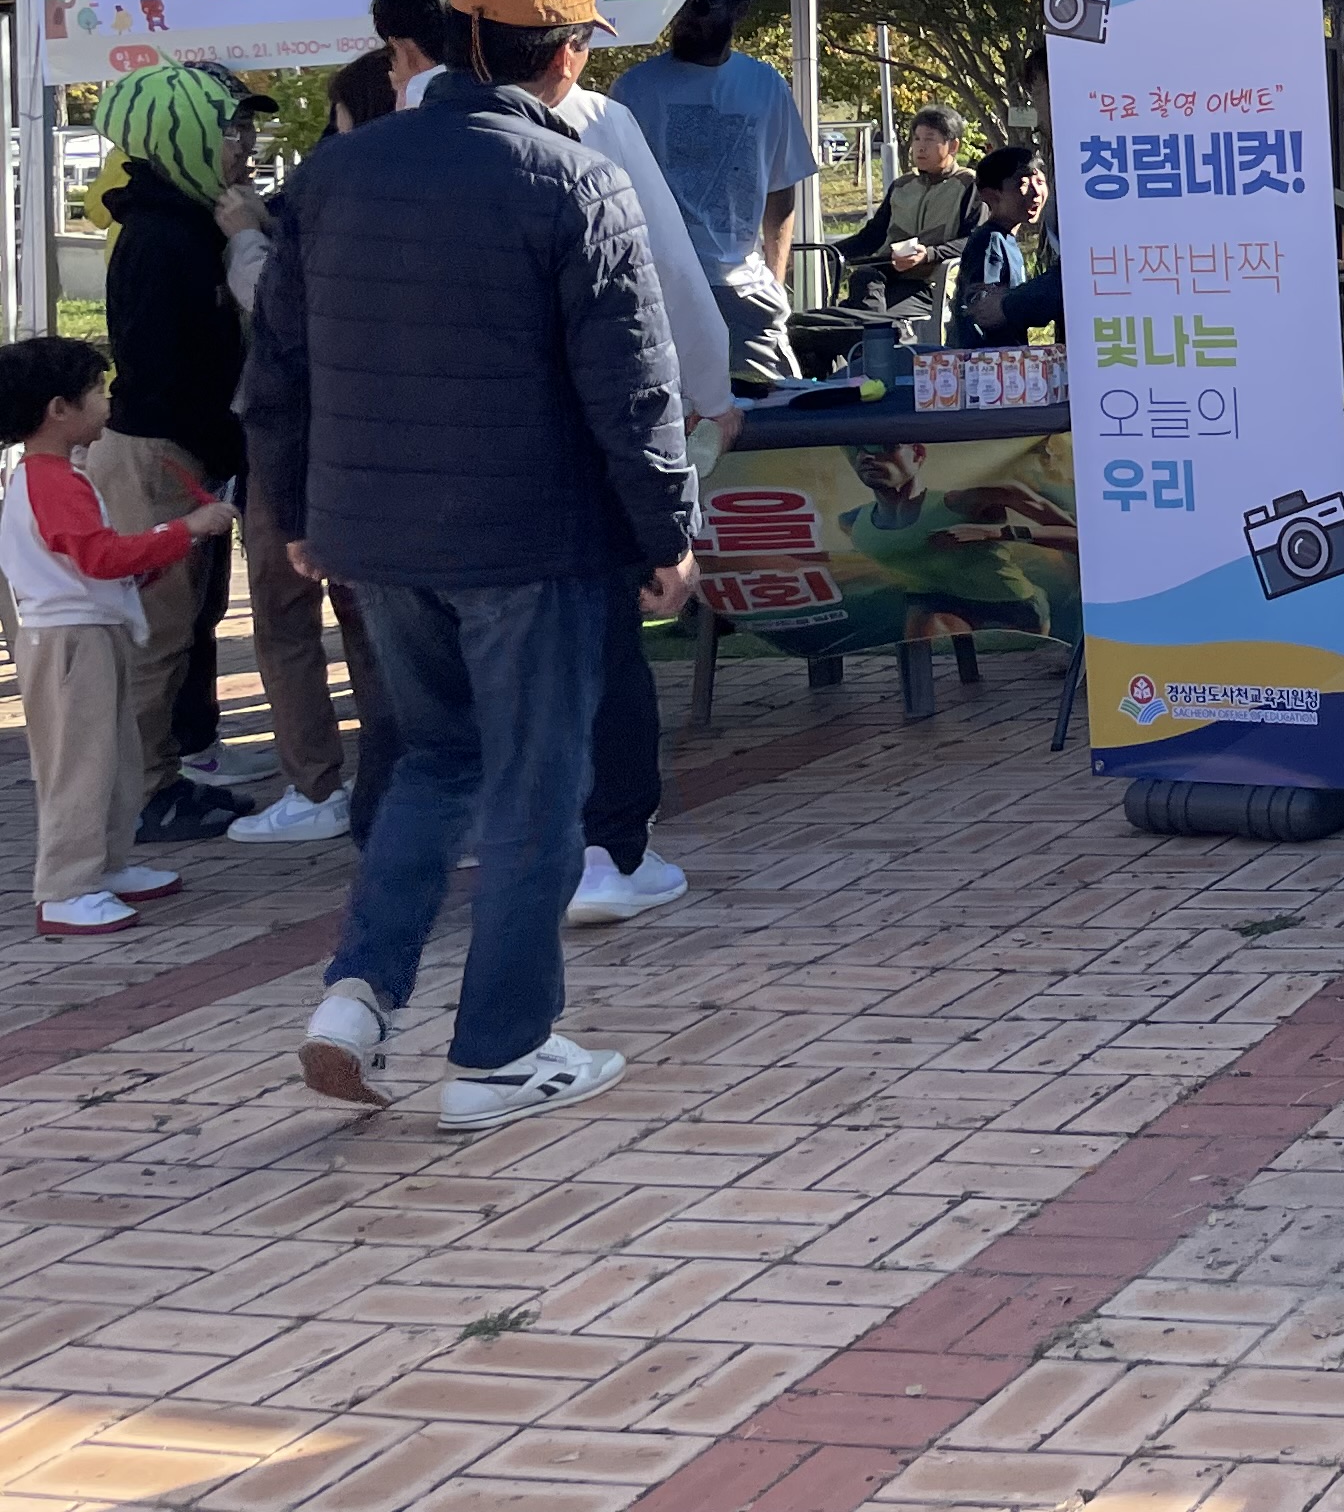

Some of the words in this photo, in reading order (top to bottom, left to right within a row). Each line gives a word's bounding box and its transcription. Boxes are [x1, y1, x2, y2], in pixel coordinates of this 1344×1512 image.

[1079, 129, 1306, 200] 청렴네컷!
[1089, 241, 1285, 297] 반짝반짝
[1093, 314, 1238, 368] 빛나는
[1100, 386, 1240, 440] 오늘의
[1102, 459, 1196, 512] 우리
[1166, 684, 1320, 710] 경상남도사천교육지원청
